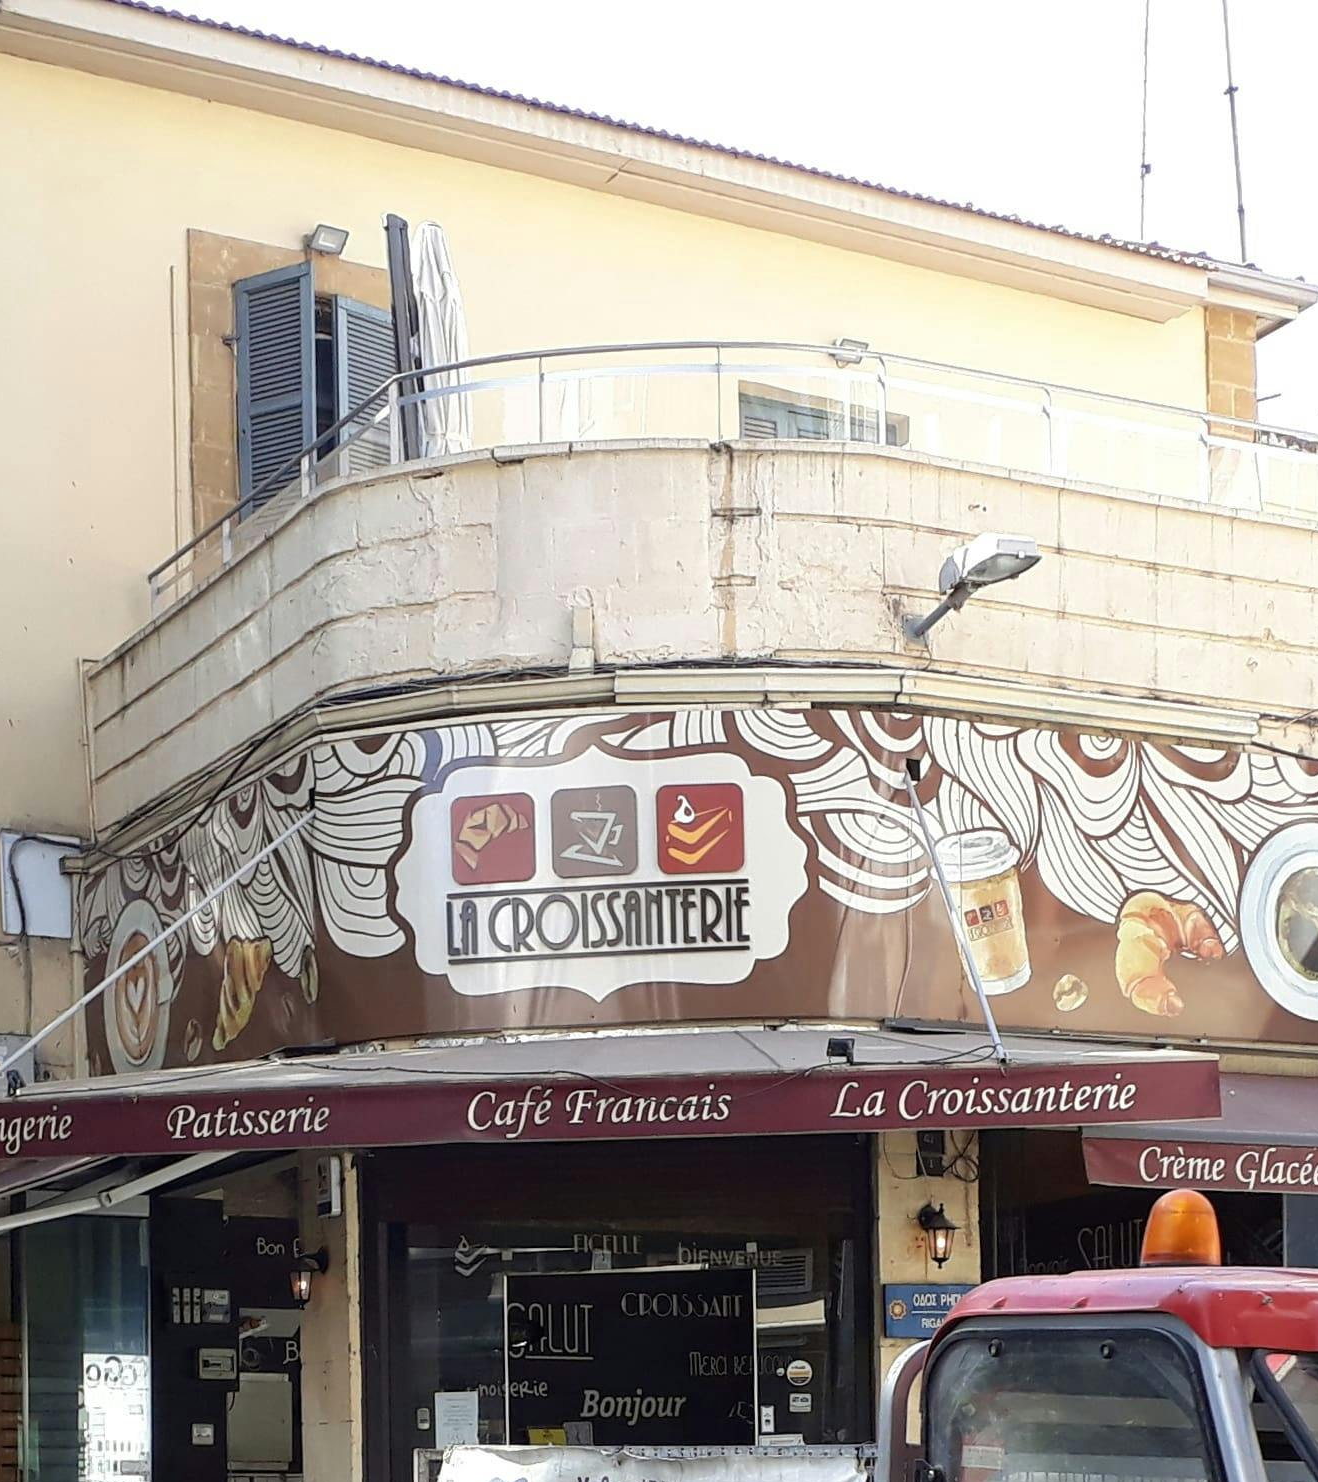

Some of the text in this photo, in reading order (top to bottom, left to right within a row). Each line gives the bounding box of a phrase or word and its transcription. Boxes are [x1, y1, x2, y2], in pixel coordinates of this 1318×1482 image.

[446, 886, 751, 957] LA CROISSANTERIE
[467, 1086, 553, 1139] Café
[830, 1073, 1137, 1118] La Croissanterie
[167, 1096, 330, 1140] Patisserie
[1138, 1145, 1226, 1184] Crème
[256, 1236, 285, 1255] Bon
[913, 1294, 937, 1306] ΟΔΟΣ
[580, 1389, 687, 1425] Bonjour
